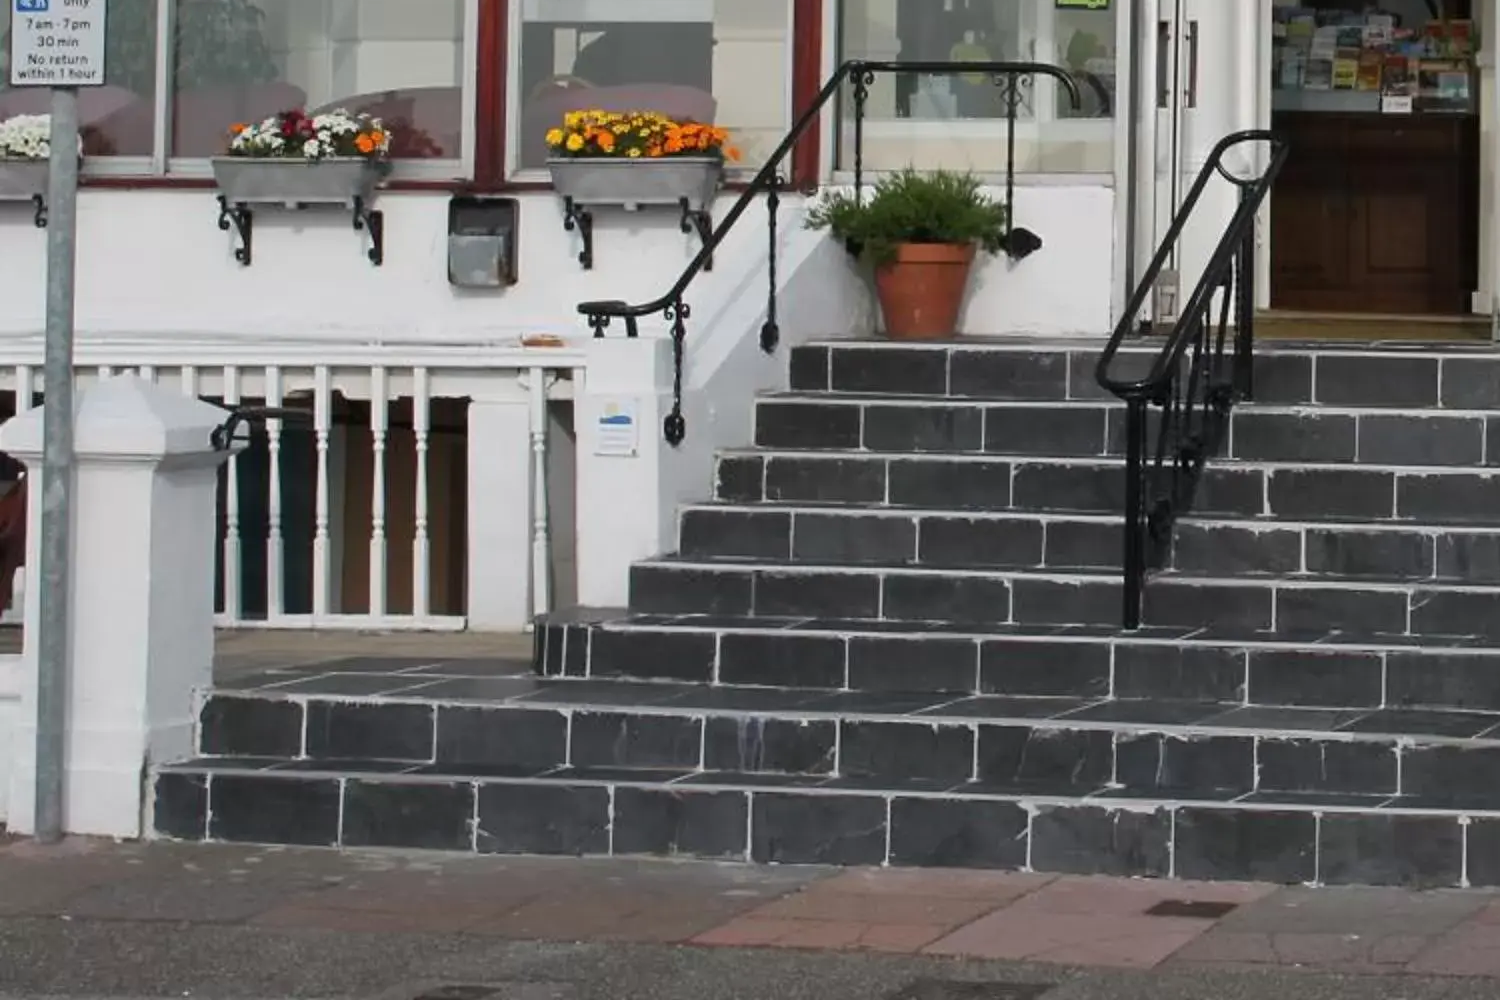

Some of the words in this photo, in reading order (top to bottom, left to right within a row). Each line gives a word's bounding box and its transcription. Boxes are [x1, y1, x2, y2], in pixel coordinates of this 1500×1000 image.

[36, 35, 55, 48] 30
[57, 36, 79, 48] min
[27, 53, 46, 65] No
[48, 53, 89, 65] return
[17, 67, 55, 79] within
[59, 67, 65, 79] 1
[68, 67, 97, 80] hour
